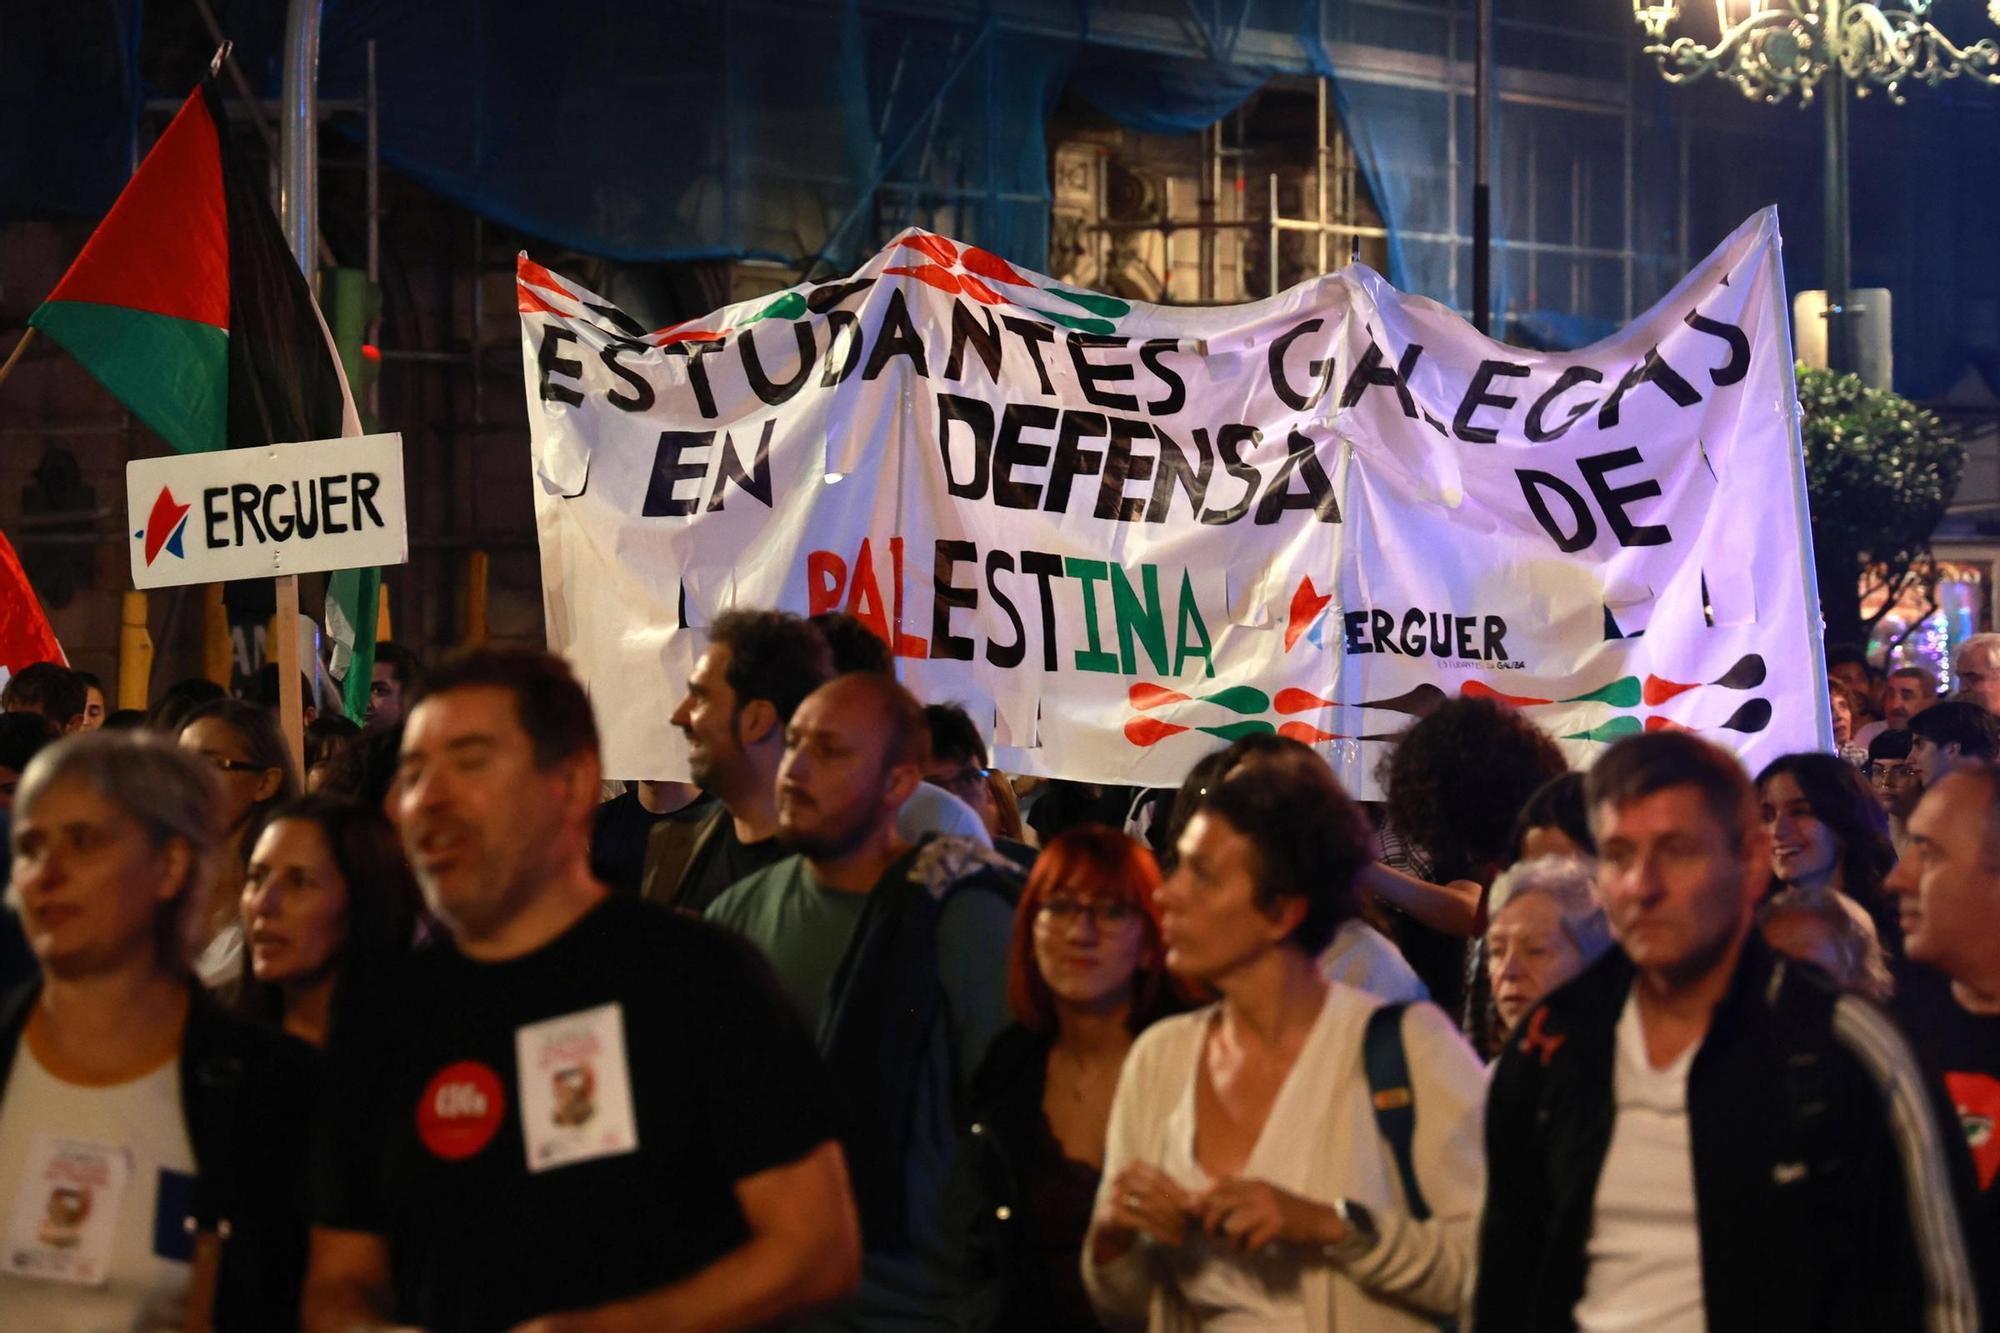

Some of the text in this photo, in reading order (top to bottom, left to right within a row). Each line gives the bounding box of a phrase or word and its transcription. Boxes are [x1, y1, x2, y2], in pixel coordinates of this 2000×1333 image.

[538, 287, 1186, 418] ESTUDANTES
[203, 472, 384, 549] ERGUER
[642, 393, 1673, 553] EN DEFENSA DE
[807, 537, 1216, 678] PALESTINA
[1344, 607, 1509, 661] ERGUER
